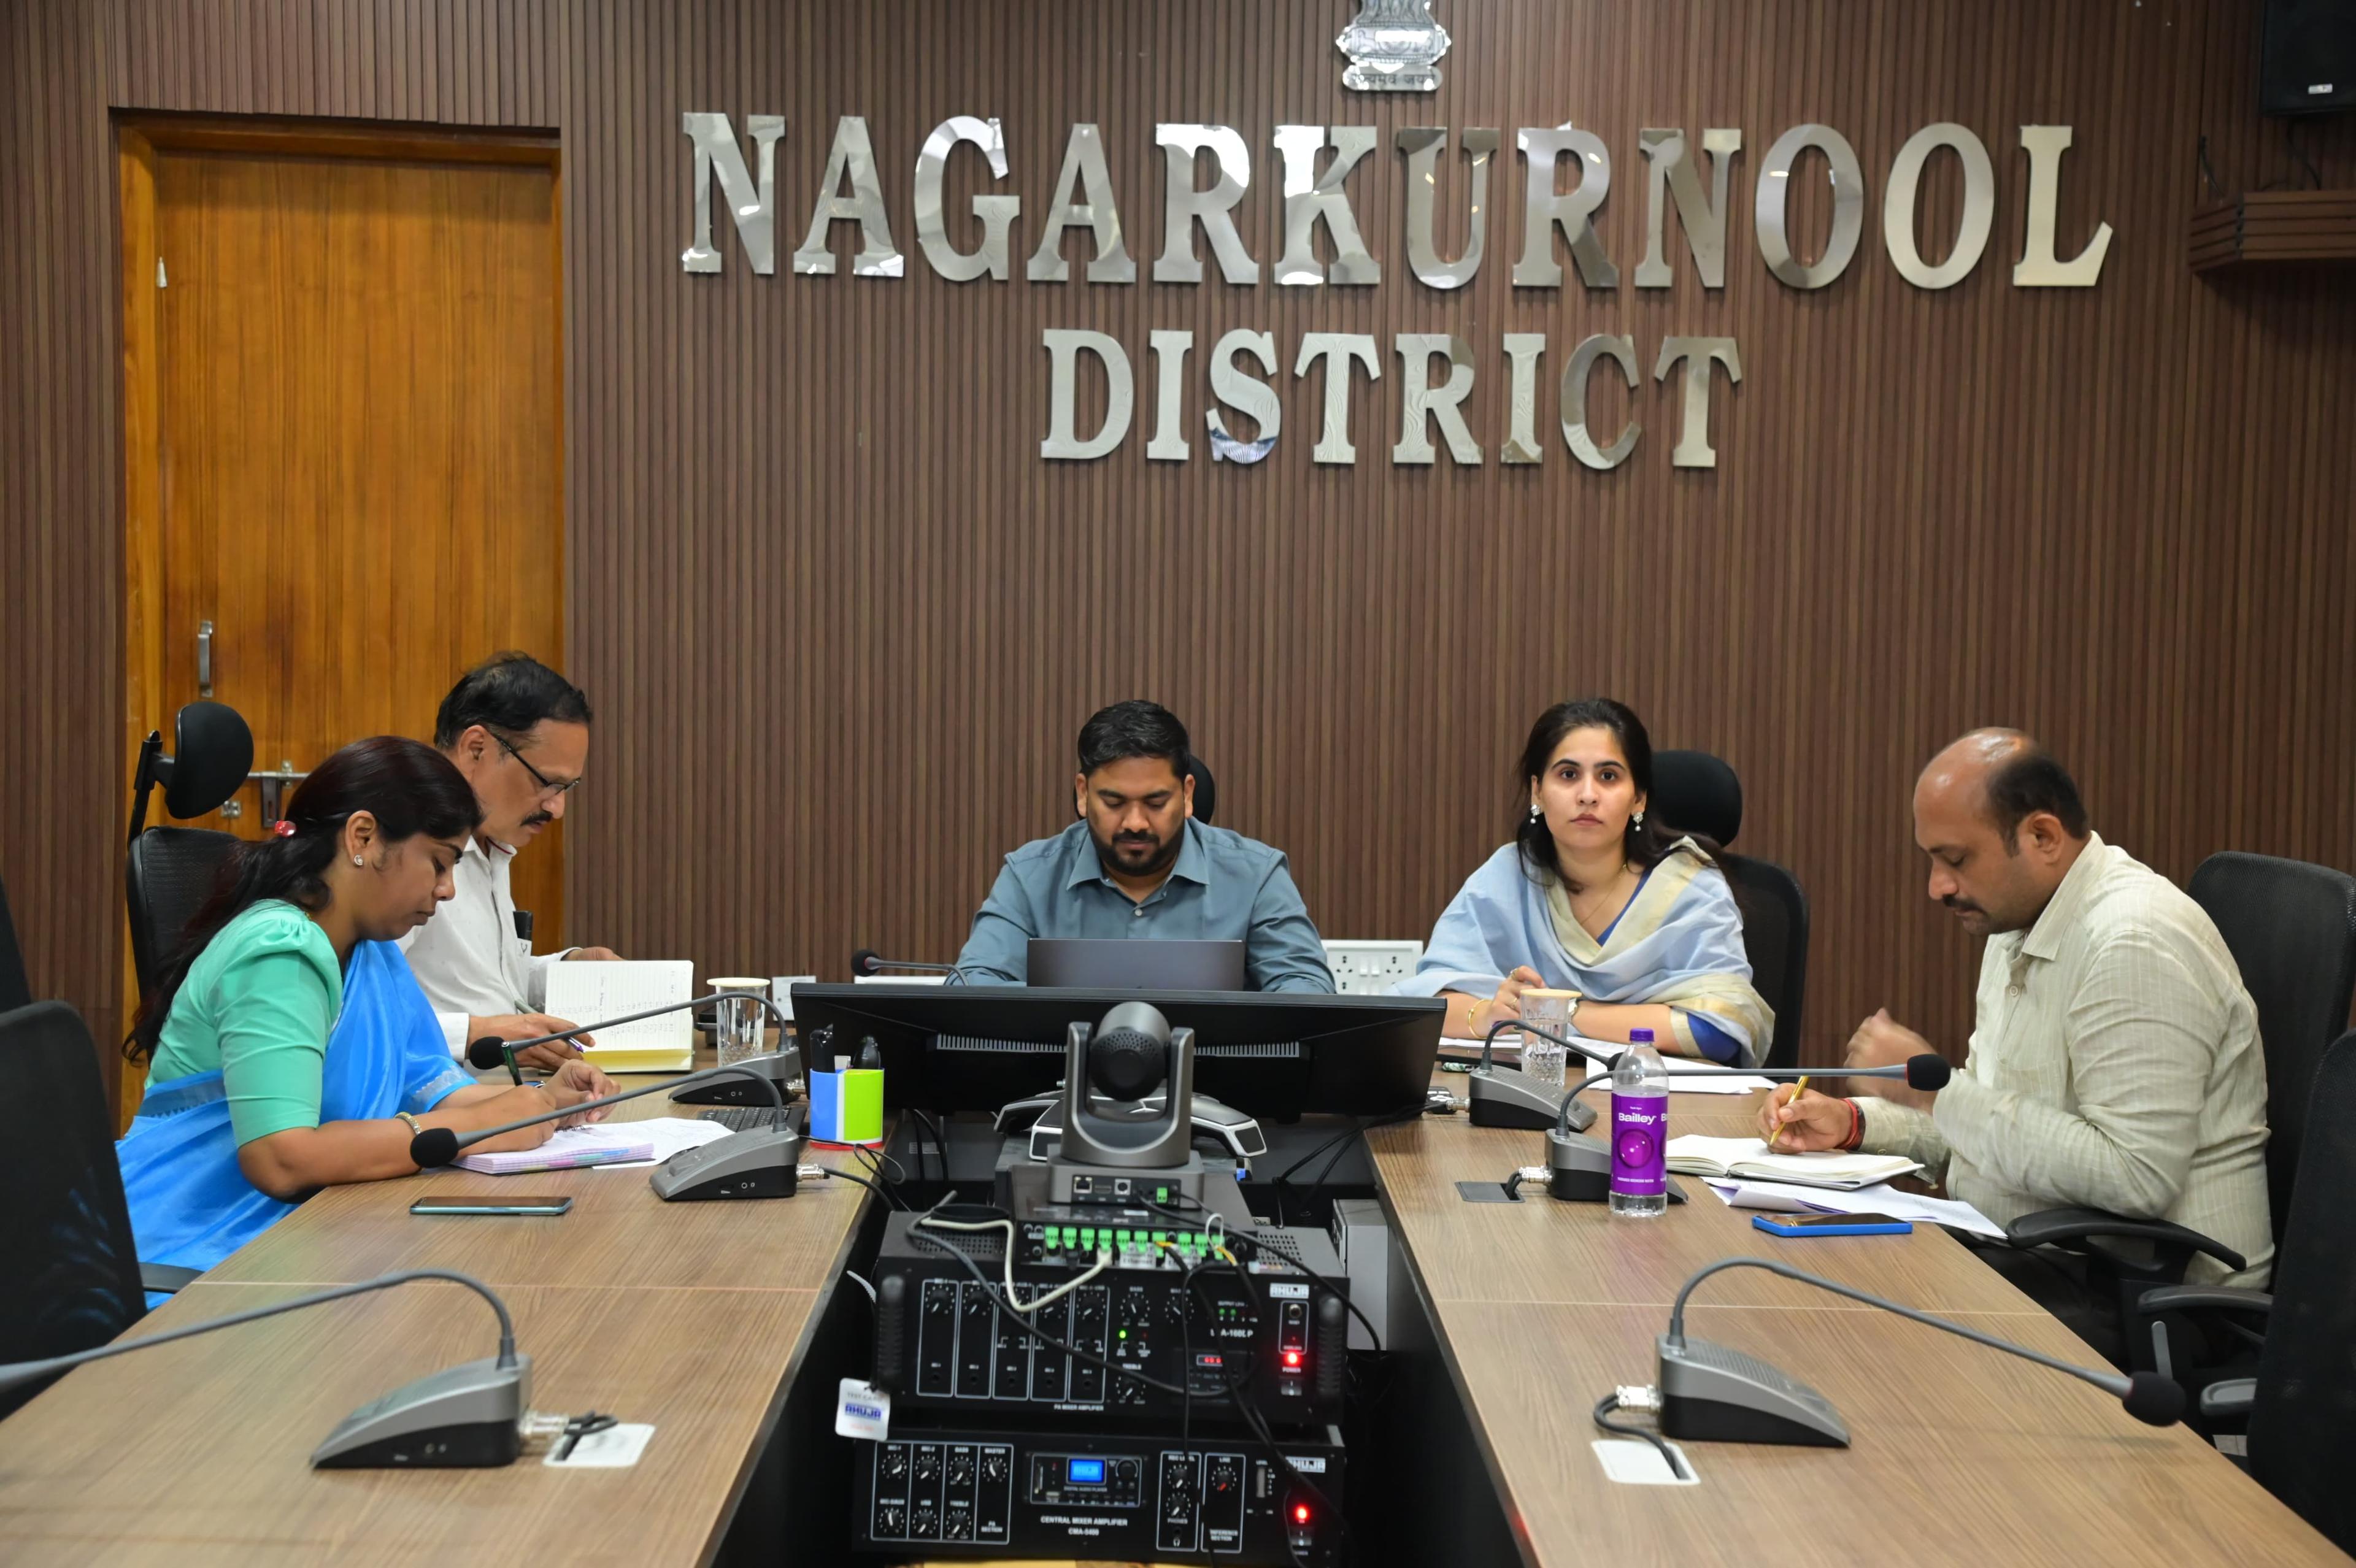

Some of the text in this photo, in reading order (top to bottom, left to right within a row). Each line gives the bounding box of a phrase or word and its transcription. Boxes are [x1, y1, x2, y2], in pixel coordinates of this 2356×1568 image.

[682, 112, 2113, 290] NAGARKURNOOL
[1041, 329, 1742, 470] DISTRICT
[1619, 1113, 1655, 1125] Bailley
[1270, 1283, 1309, 1299] AHUJA
[845, 1402, 882, 1421] AHUJA
[1040, 1516, 1071, 1524] CENTRAL
[1094, 1518, 1128, 1526] AMPLIFIER
